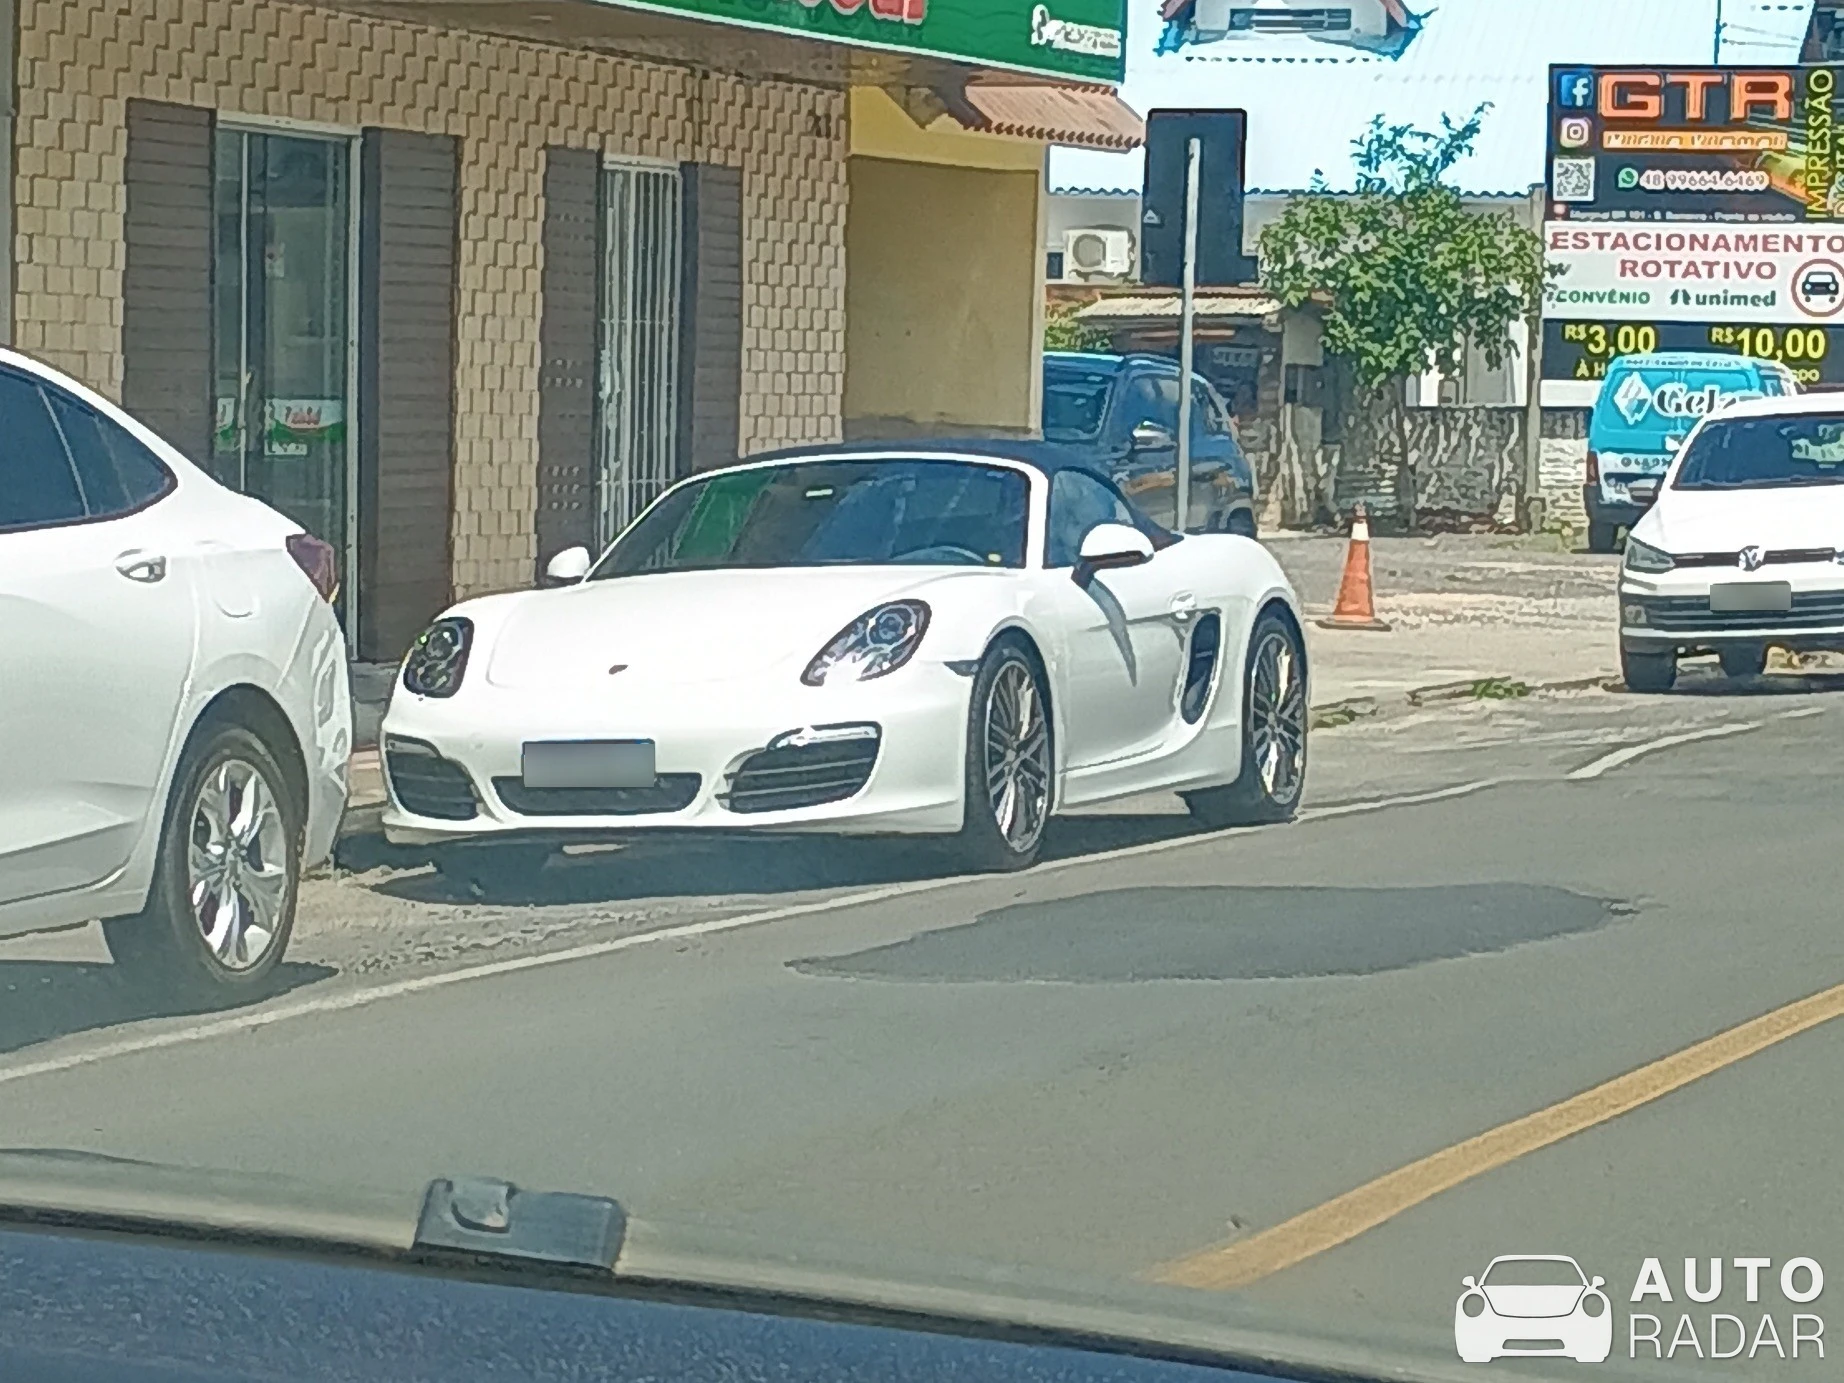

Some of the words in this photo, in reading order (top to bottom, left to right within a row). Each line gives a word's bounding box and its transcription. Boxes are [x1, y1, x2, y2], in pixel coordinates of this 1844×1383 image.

[1600, 74, 1793, 120] GTR
[1805, 69, 1833, 218] IMPRESSÃO
[1551, 231, 1844, 254] ESTACIONAMENTO
[1619, 259, 1777, 280] ROTATIVO
[1556, 288, 1651, 305] CONVÊNIO
[1695, 290, 1777, 307] unimed
